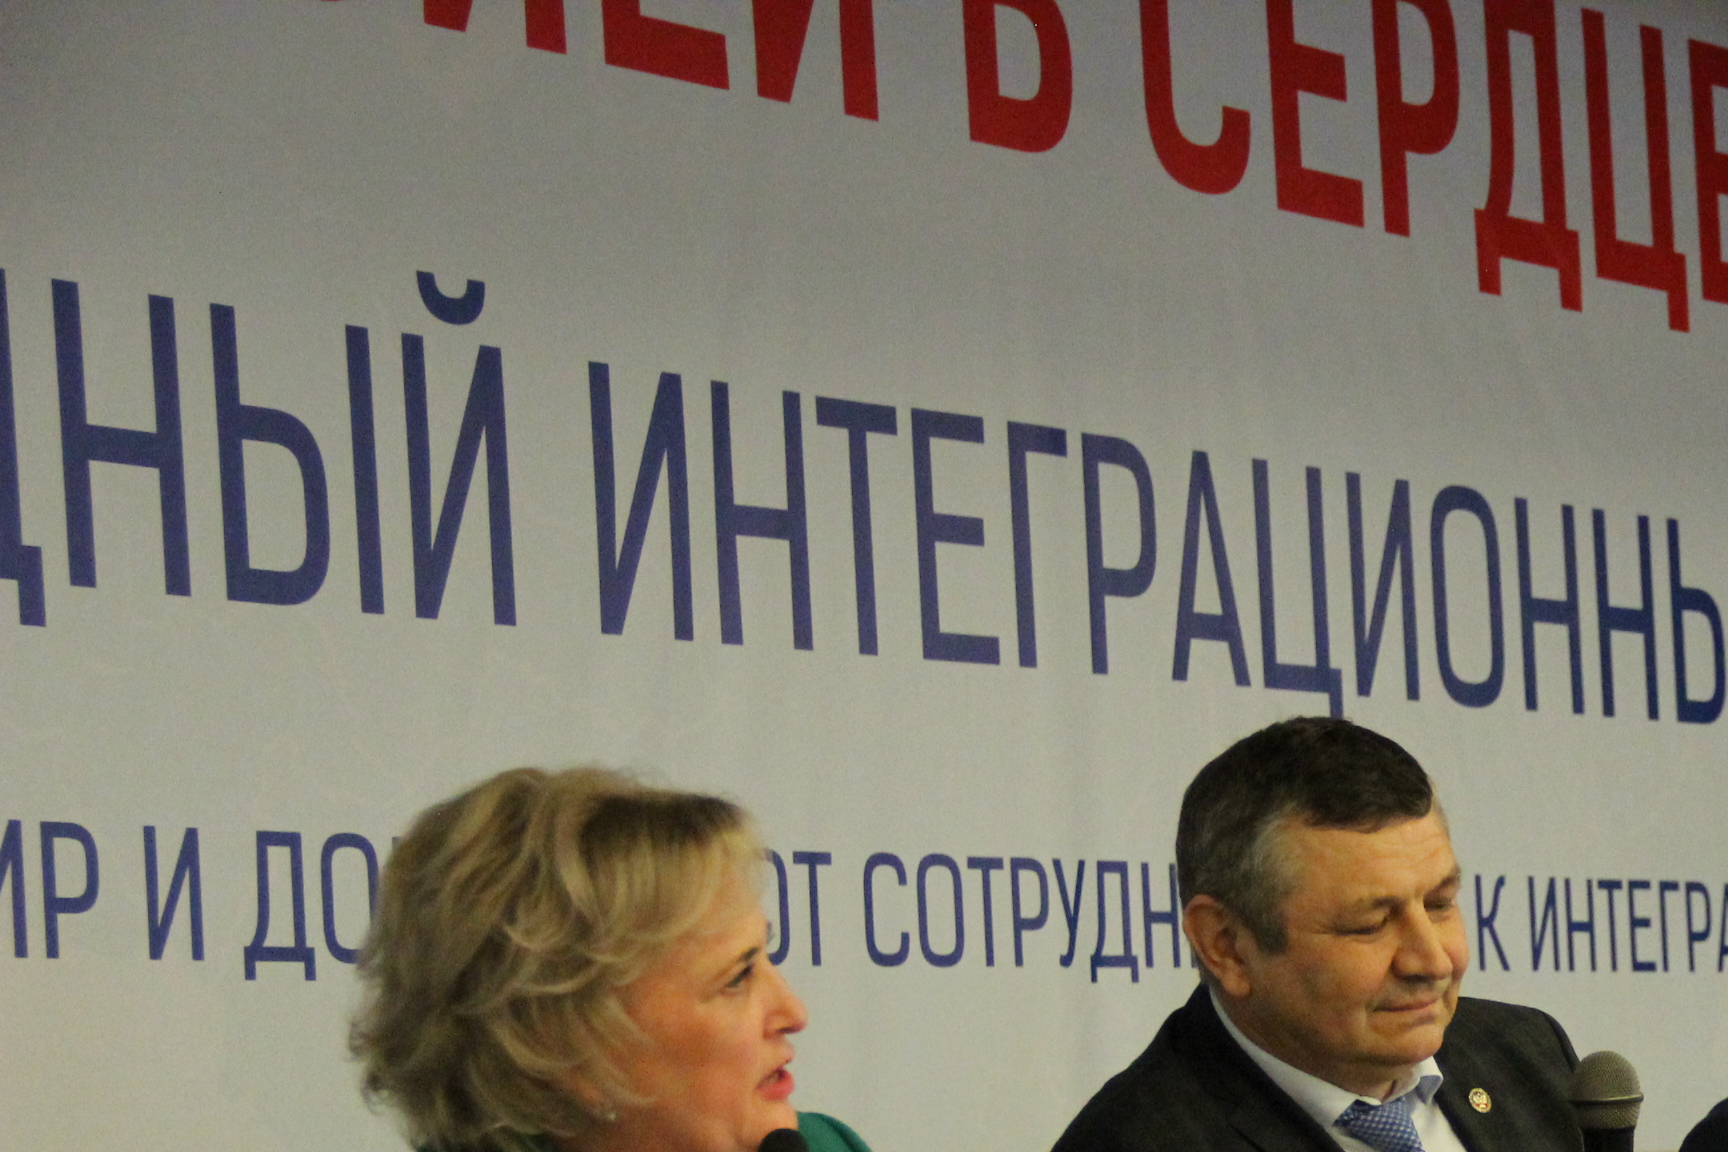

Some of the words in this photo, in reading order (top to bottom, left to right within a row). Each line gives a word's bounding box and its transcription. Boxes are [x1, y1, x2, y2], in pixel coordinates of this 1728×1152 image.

[0, 268, 517, 628] НЫЙ
[143, 825, 205, 961] И
[1475, 874, 1510, 972] К
